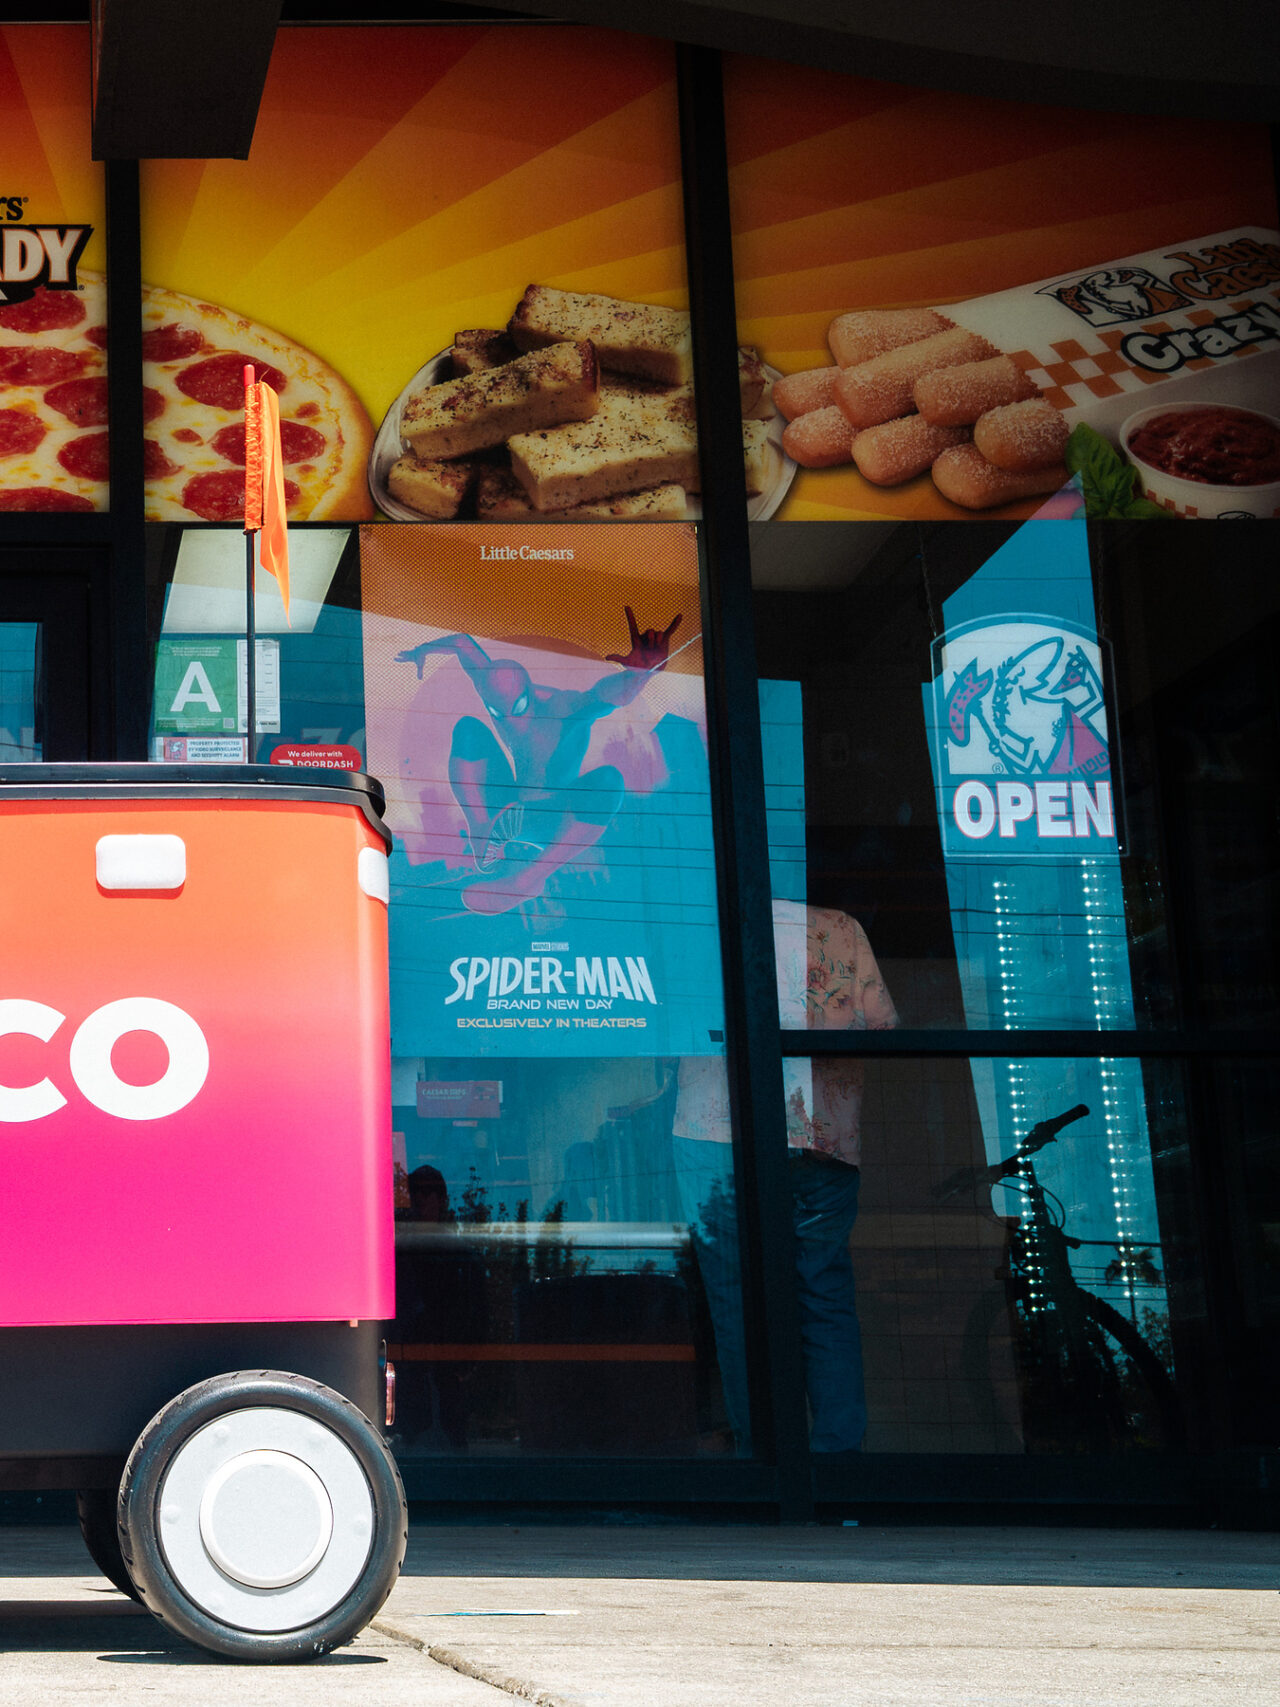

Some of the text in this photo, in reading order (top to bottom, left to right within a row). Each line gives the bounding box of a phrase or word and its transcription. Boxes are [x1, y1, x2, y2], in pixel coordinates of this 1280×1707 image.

[480, 545, 576, 561] Little Caesars
[170, 660, 222, 713] A
[297, 760, 354, 768] DOORDASH
[953, 780, 1114, 839] OPEN
[445, 956, 658, 1005] SPIDER-MAN
[487, 1000, 613, 1010] BRAND NEW DAY
[457, 1018, 647, 1028] EXCLUSIVELY IN THEATERS
